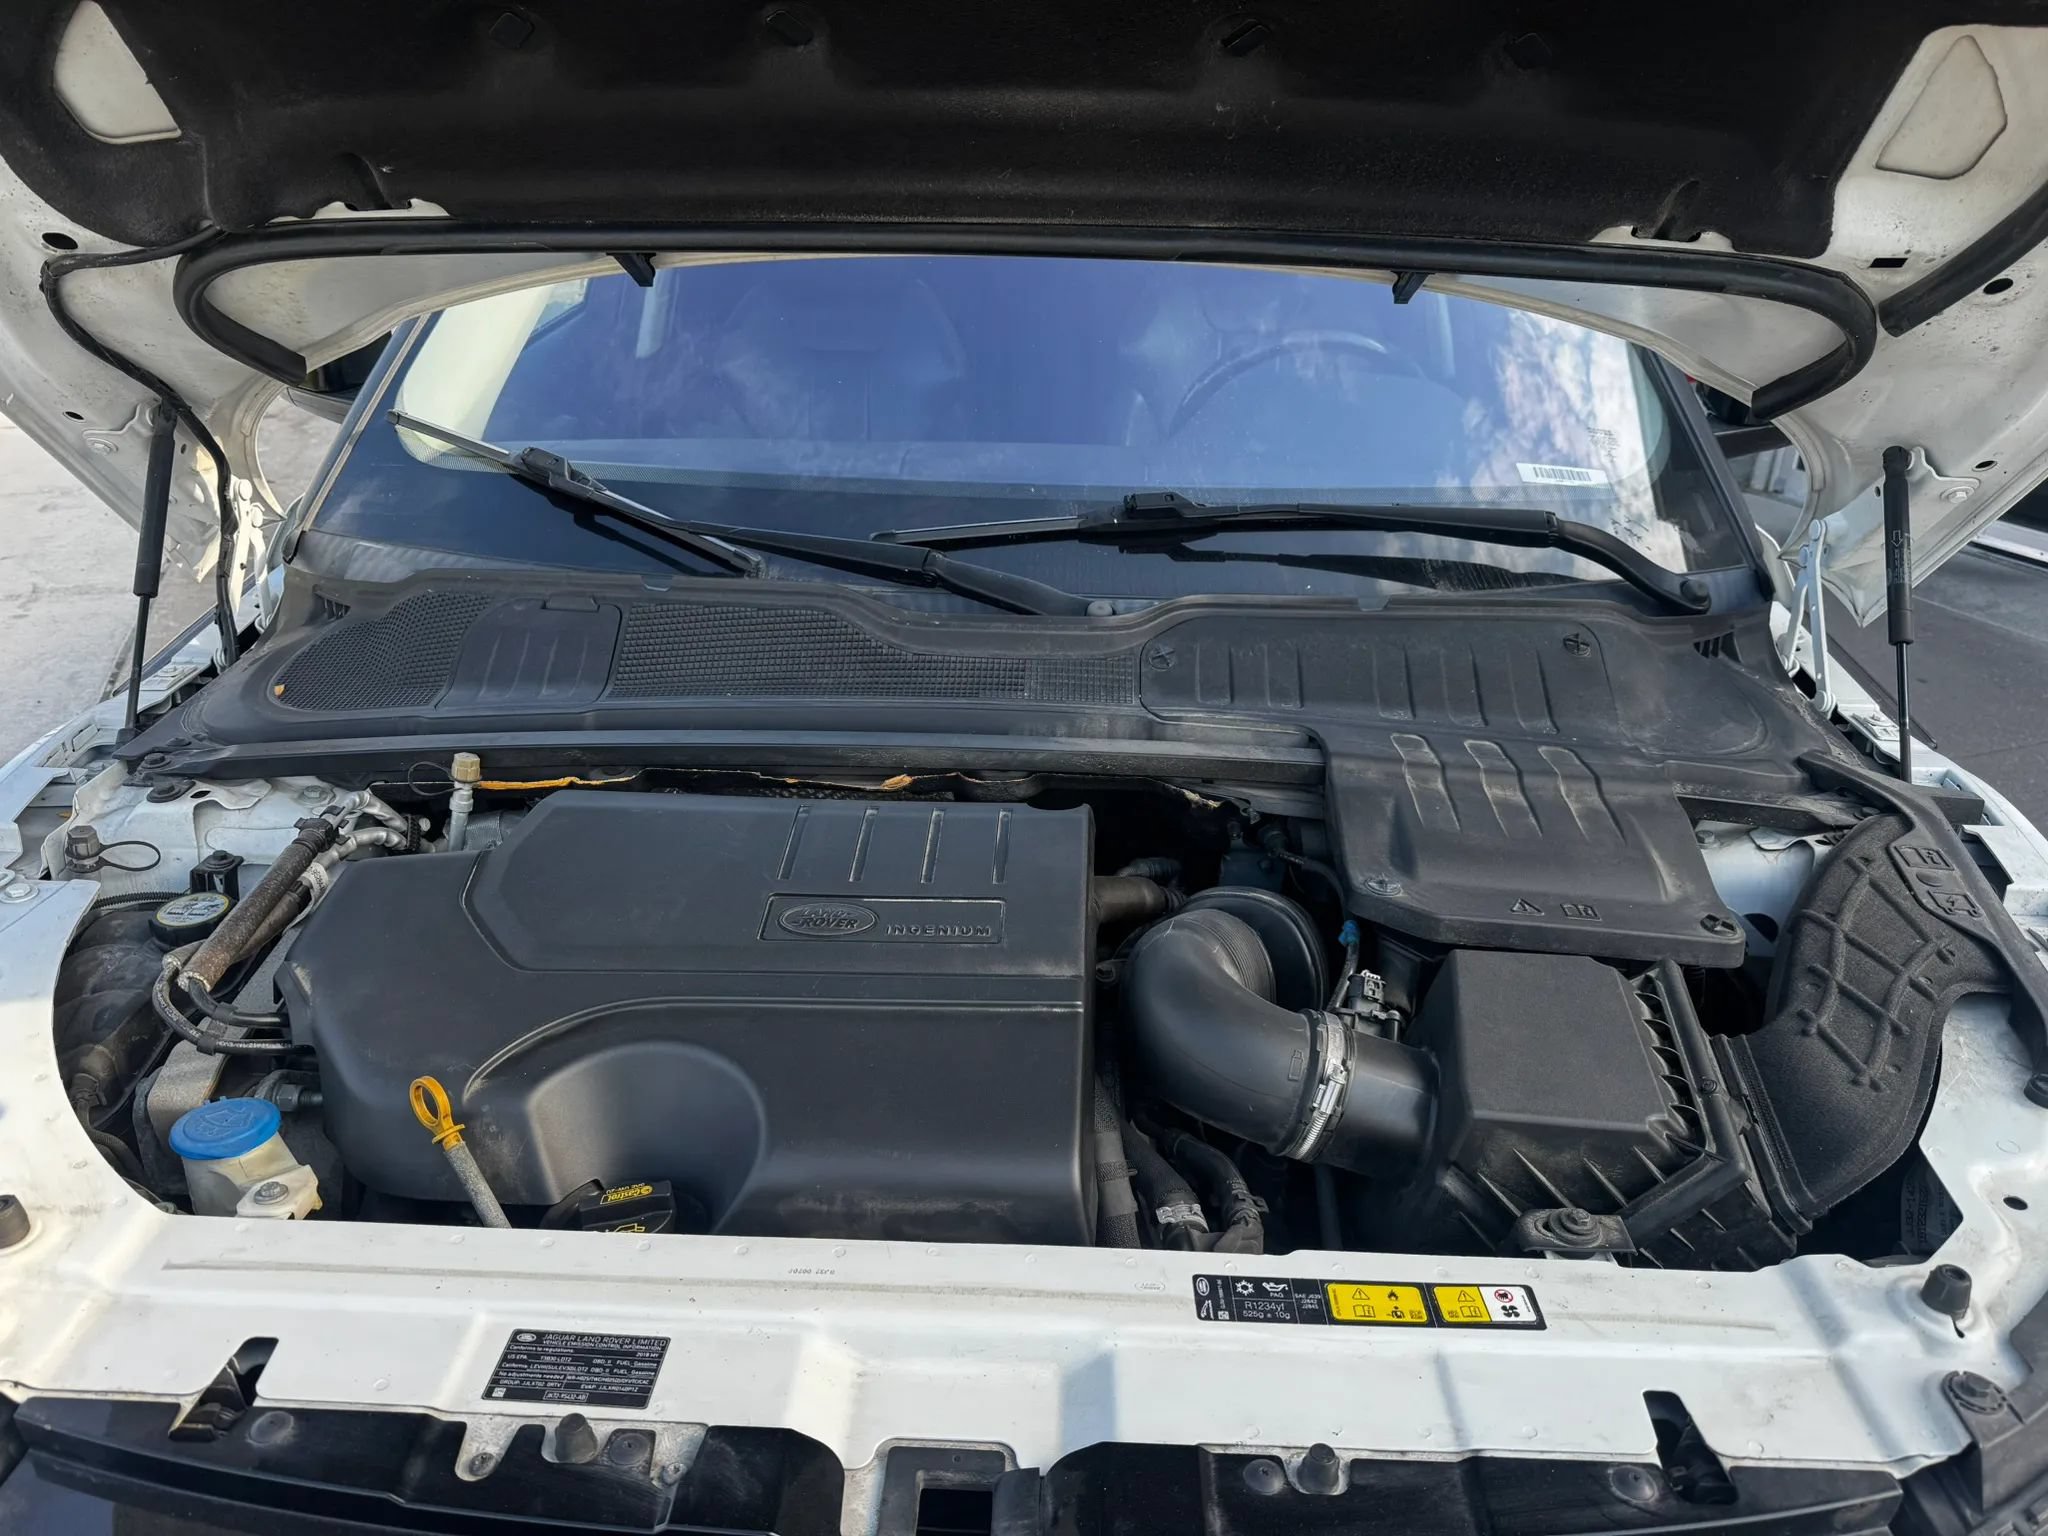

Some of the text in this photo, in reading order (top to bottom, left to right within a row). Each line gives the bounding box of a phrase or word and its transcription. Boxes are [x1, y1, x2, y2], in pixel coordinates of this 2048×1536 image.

[802, 917, 859, 930] ROVER
[885, 925, 992, 937] INGENIUM
[607, 1188, 640, 1202] Castrol
[1244, 1301, 1285, 1312] R1234yf
[1242, 1310, 1264, 1319] 525g
[1275, 1311, 1291, 1320] 10g
[543, 1333, 577, 1341] JAGUAR
[578, 1335, 602, 1343] LAND
[602, 1336, 631, 1345] ROVER
[632, 1338, 667, 1347] LIMITED
[543, 1372, 565, 1380] needed
